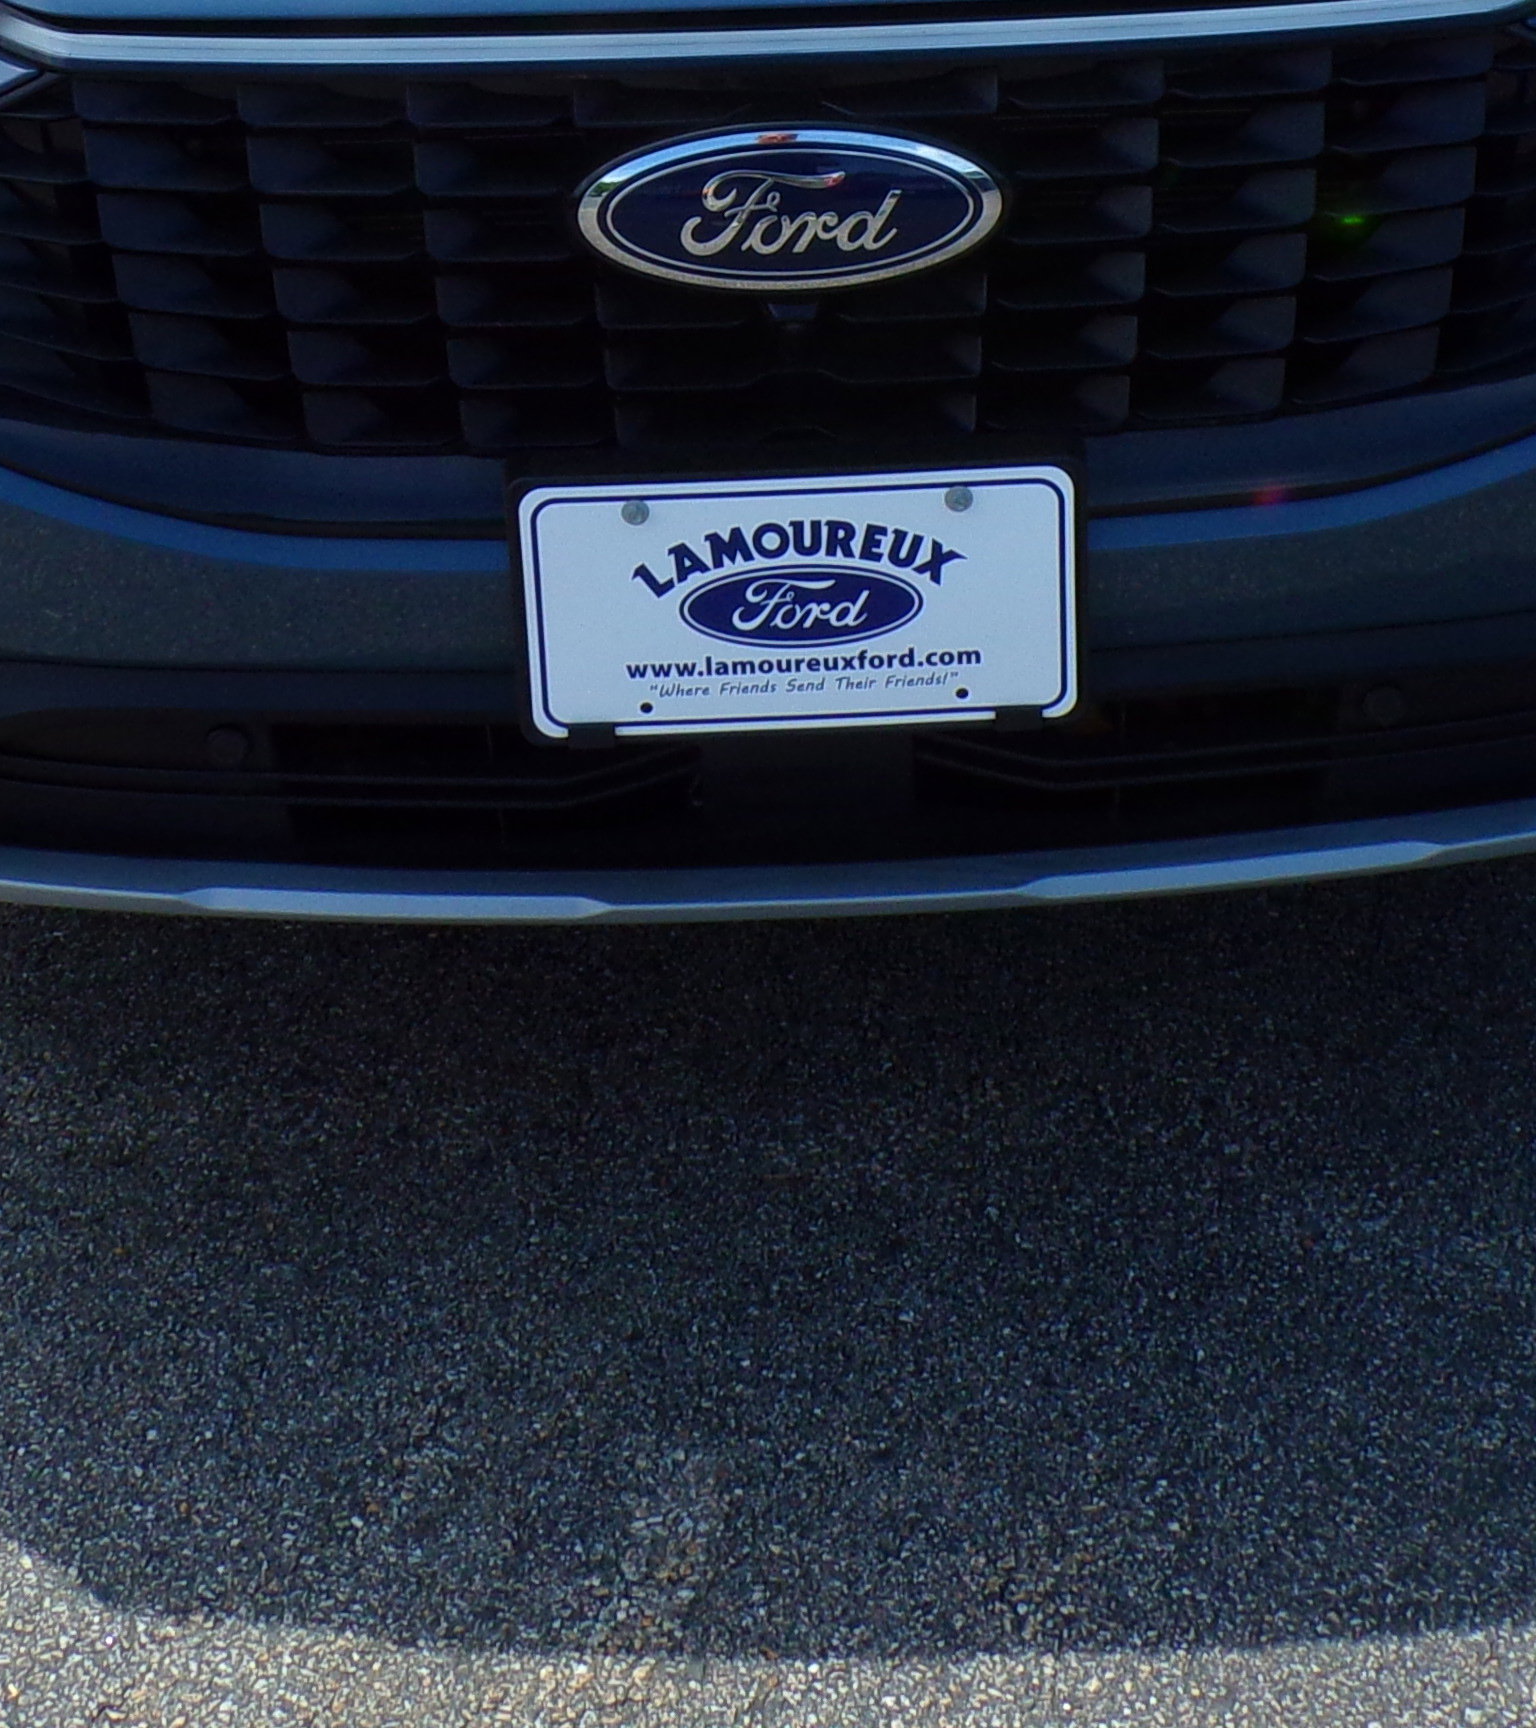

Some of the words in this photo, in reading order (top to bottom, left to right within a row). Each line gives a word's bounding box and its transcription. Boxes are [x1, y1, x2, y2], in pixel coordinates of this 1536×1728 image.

[679, 169, 903, 257] Ford
[631, 519, 968, 599] LAMOUREUX
[731, 577, 870, 632] Ford
[625, 647, 982, 680] www.lamoureuxford.com
[719, 679, 777, 696] Friends
[785, 677, 825, 693] Send
[835, 674, 877, 690] Their
